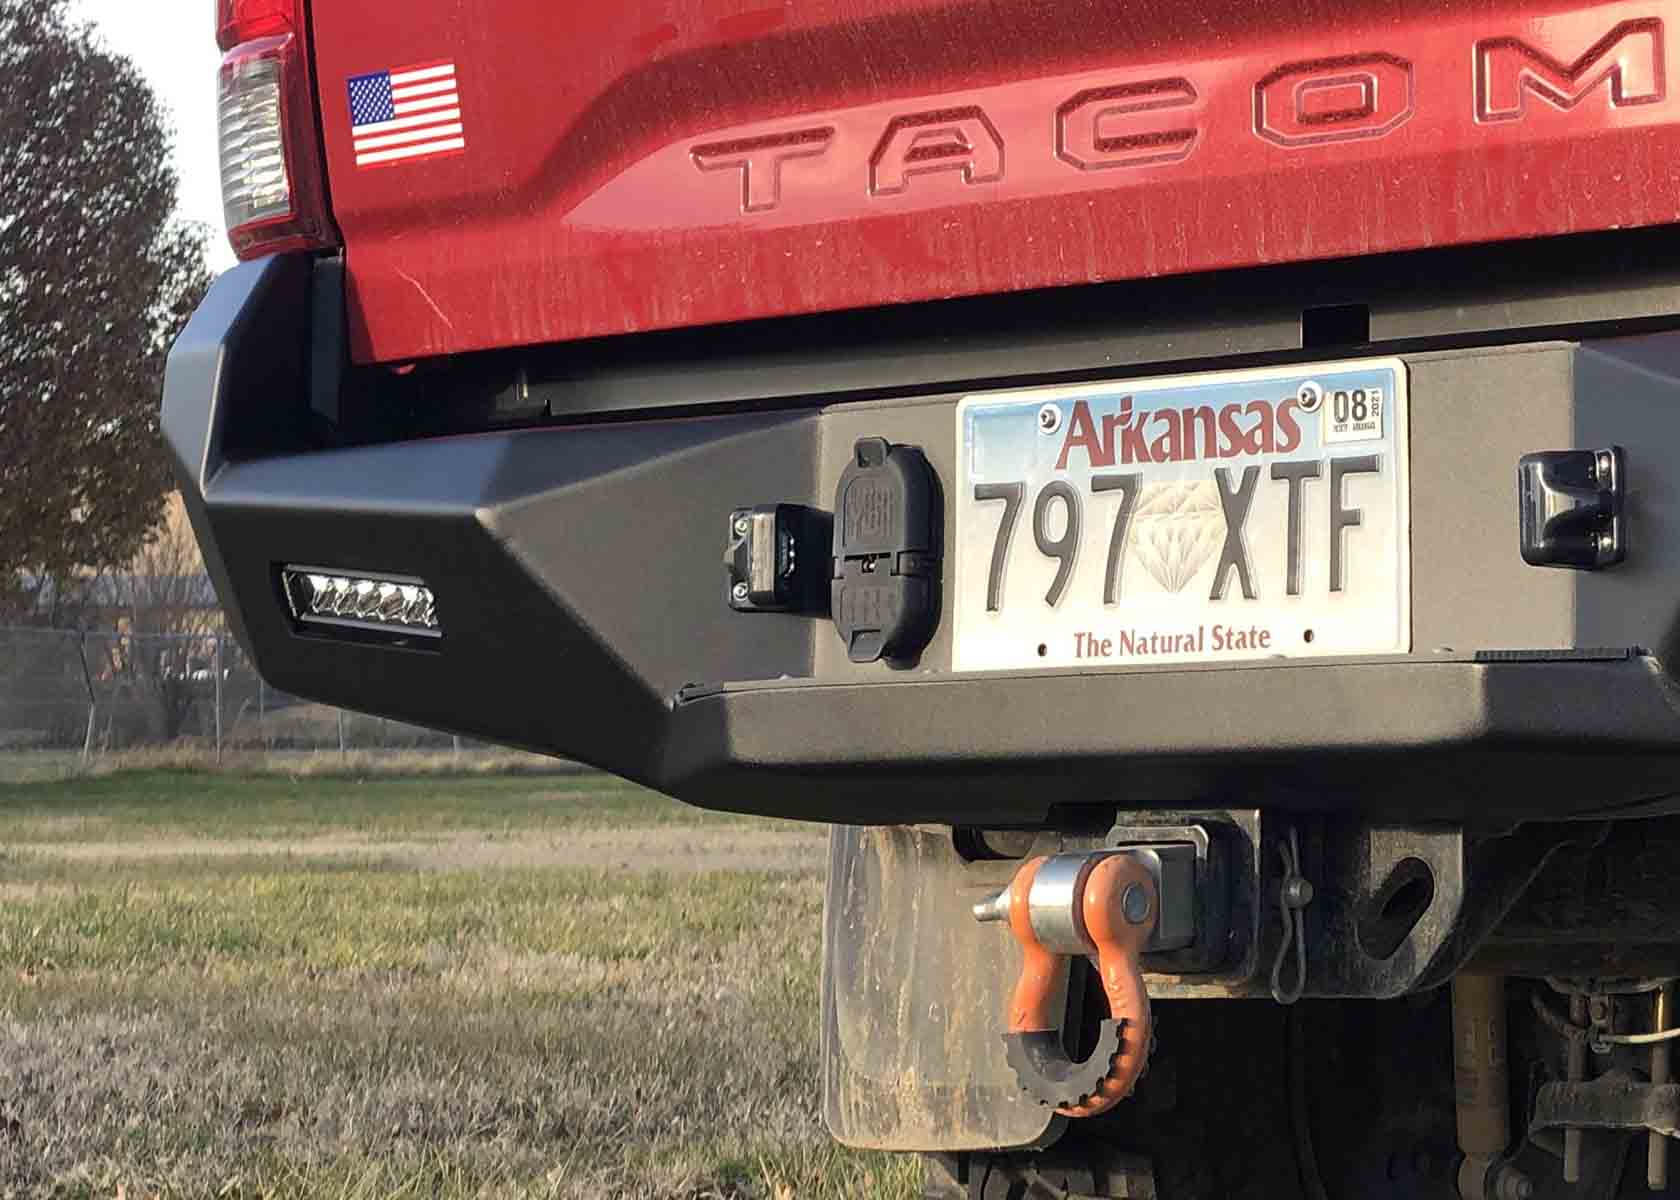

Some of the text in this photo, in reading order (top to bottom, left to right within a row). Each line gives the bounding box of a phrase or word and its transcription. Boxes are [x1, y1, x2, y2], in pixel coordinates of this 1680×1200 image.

[1333, 389, 1367, 423] 08
[1371, 389, 1379, 416] 2021
[1056, 396, 1303, 470] Arkansas
[974, 455, 1382, 612] 797 XTF
[1074, 623, 1272, 658] The Natural State
